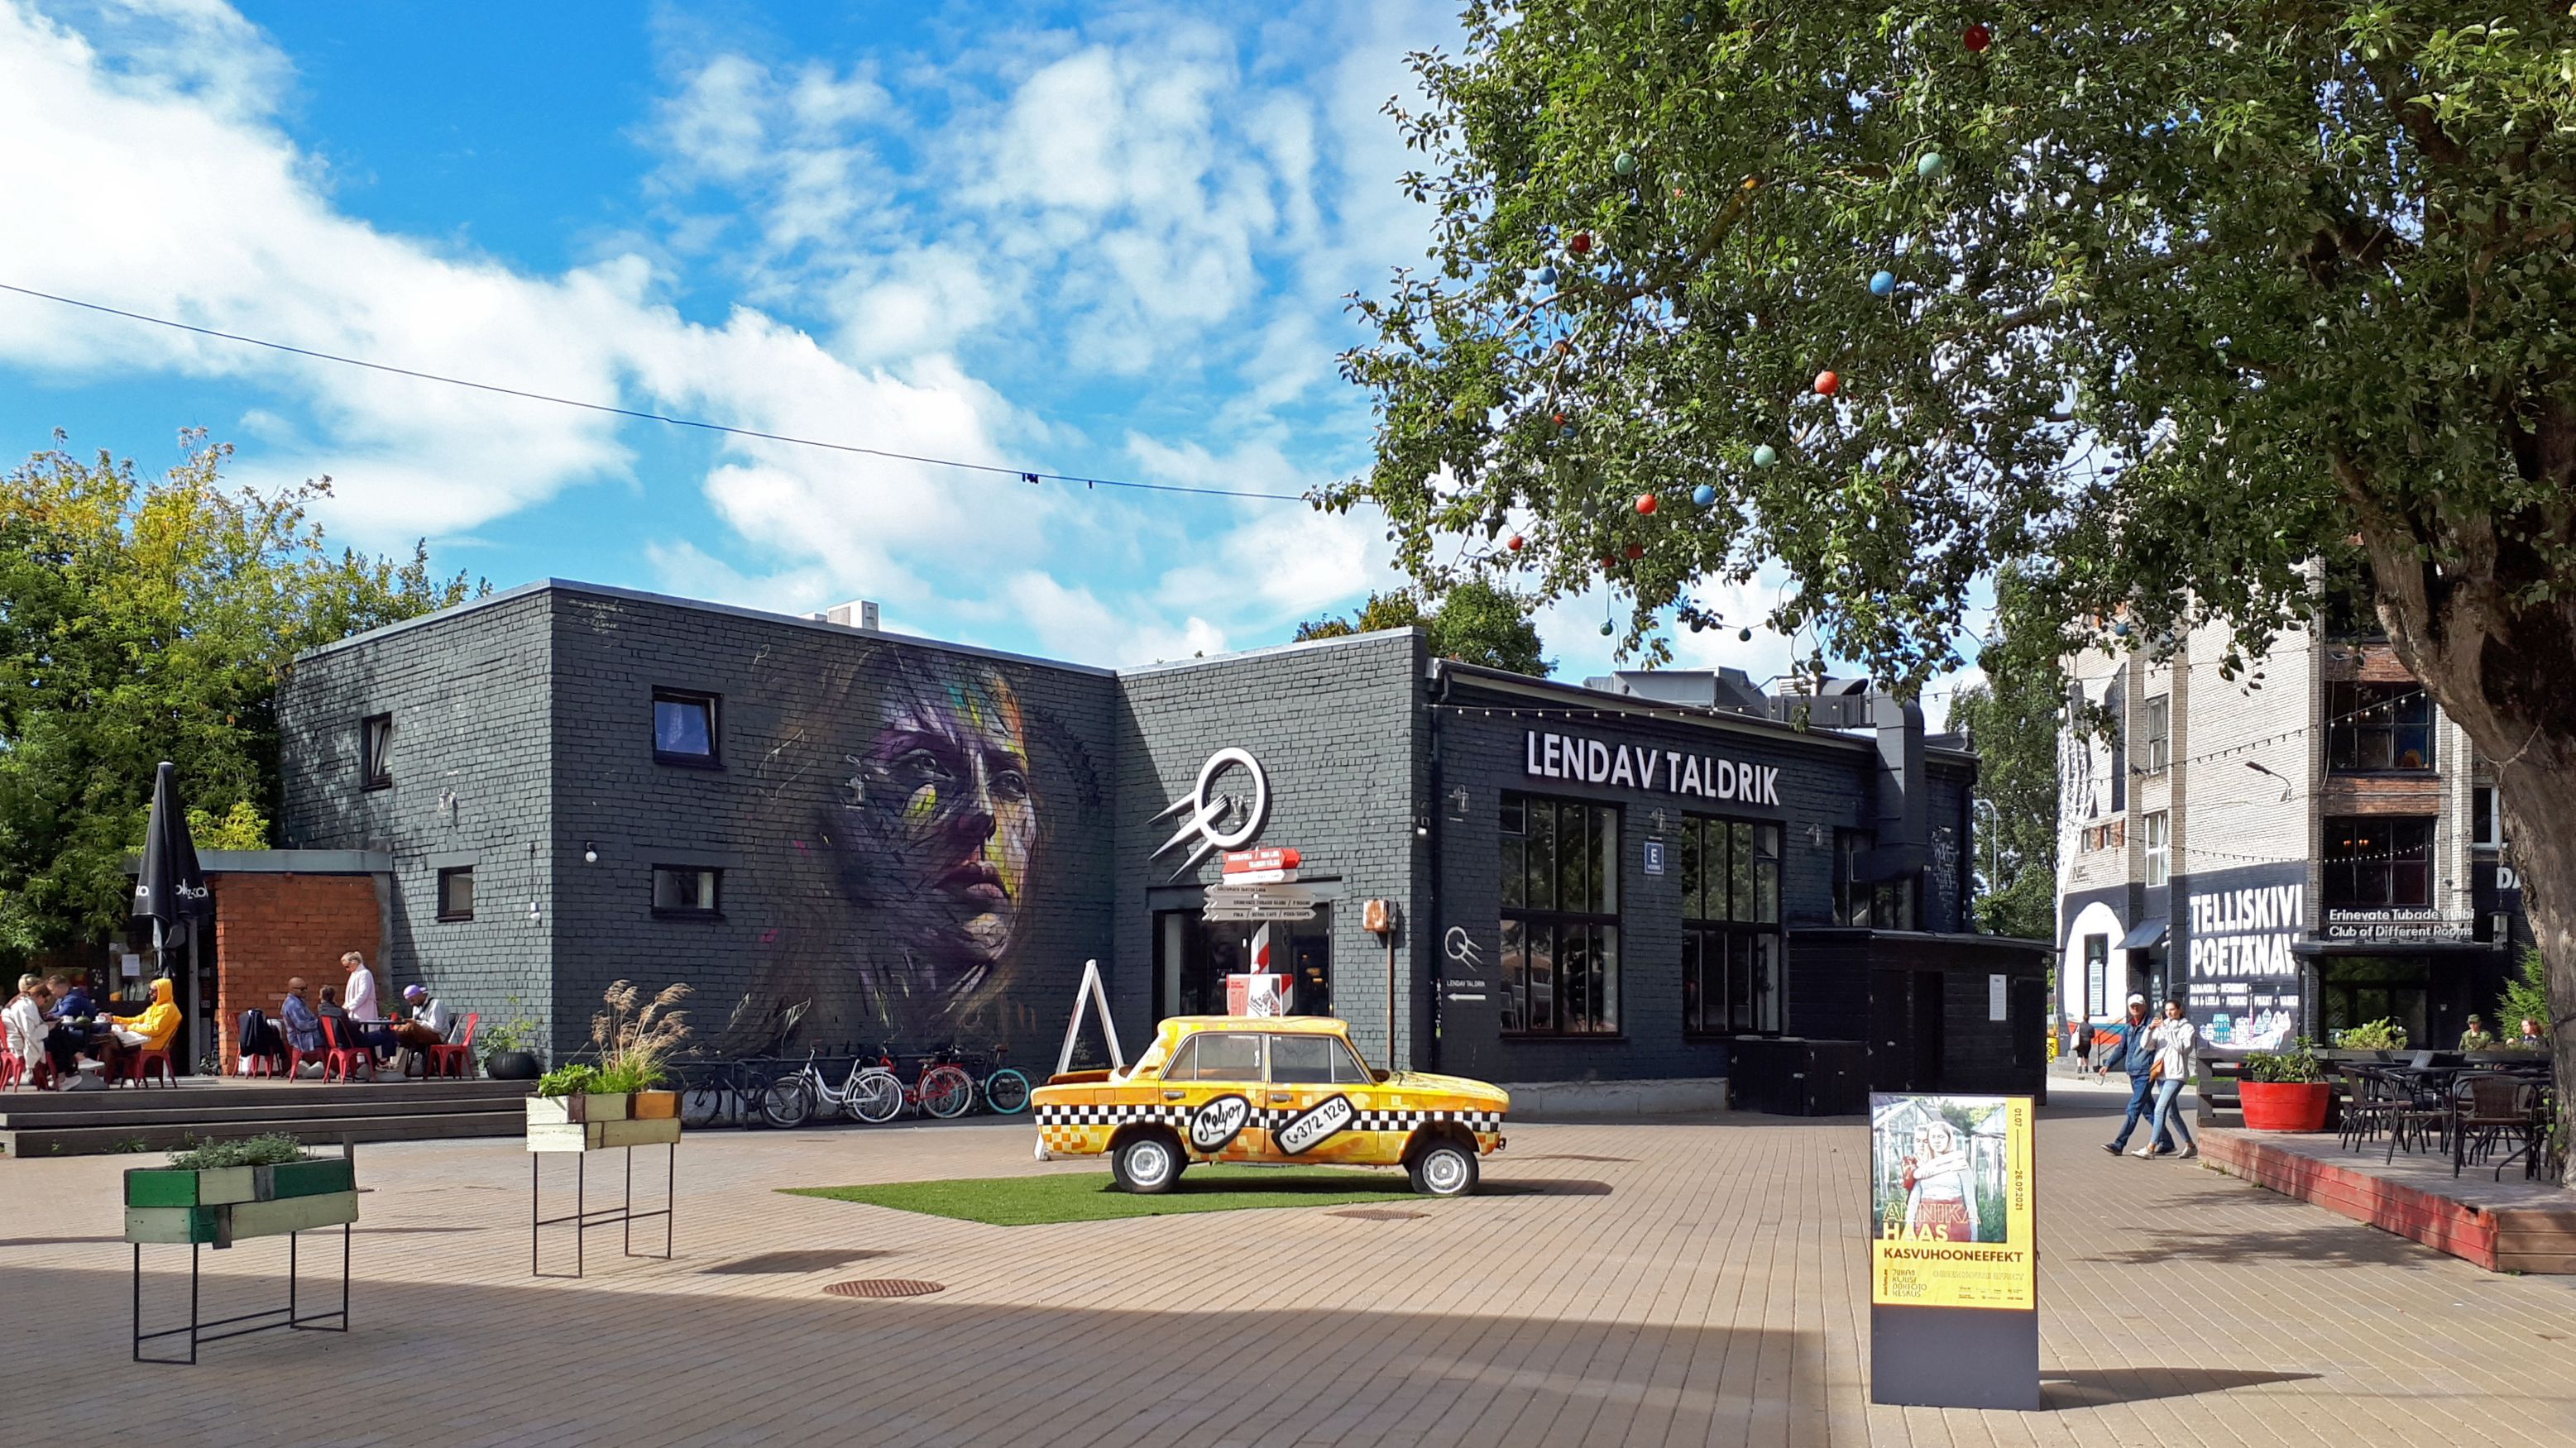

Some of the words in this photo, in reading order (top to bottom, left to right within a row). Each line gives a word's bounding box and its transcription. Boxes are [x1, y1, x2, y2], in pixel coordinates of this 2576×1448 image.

[1527, 730, 1658, 789] LENDAV
[1666, 751, 1779, 806] TALDRIK
[1651, 848, 1658, 863] E
[2190, 884, 2303, 933] TELLISKIVI
[2329, 909, 2390, 921] Erinevate
[2392, 908, 2439, 921] Tubade
[2329, 925, 2357, 937] Club
[2359, 925, 2373, 937] of
[2375, 925, 2431, 937] Different
[2433, 925, 2473, 936] Rooms
[1466, 980, 1486, 988] TALDRIK
[1324, 1098, 1347, 1121] 126
[2015, 1170, 2023, 1211] 26.09.2021
[1883, 1202, 1982, 1225] ANNIKA
[1883, 1221, 1950, 1242] HAAS
[1884, 1248, 2024, 1263] KASVUHOONEEFEKT
